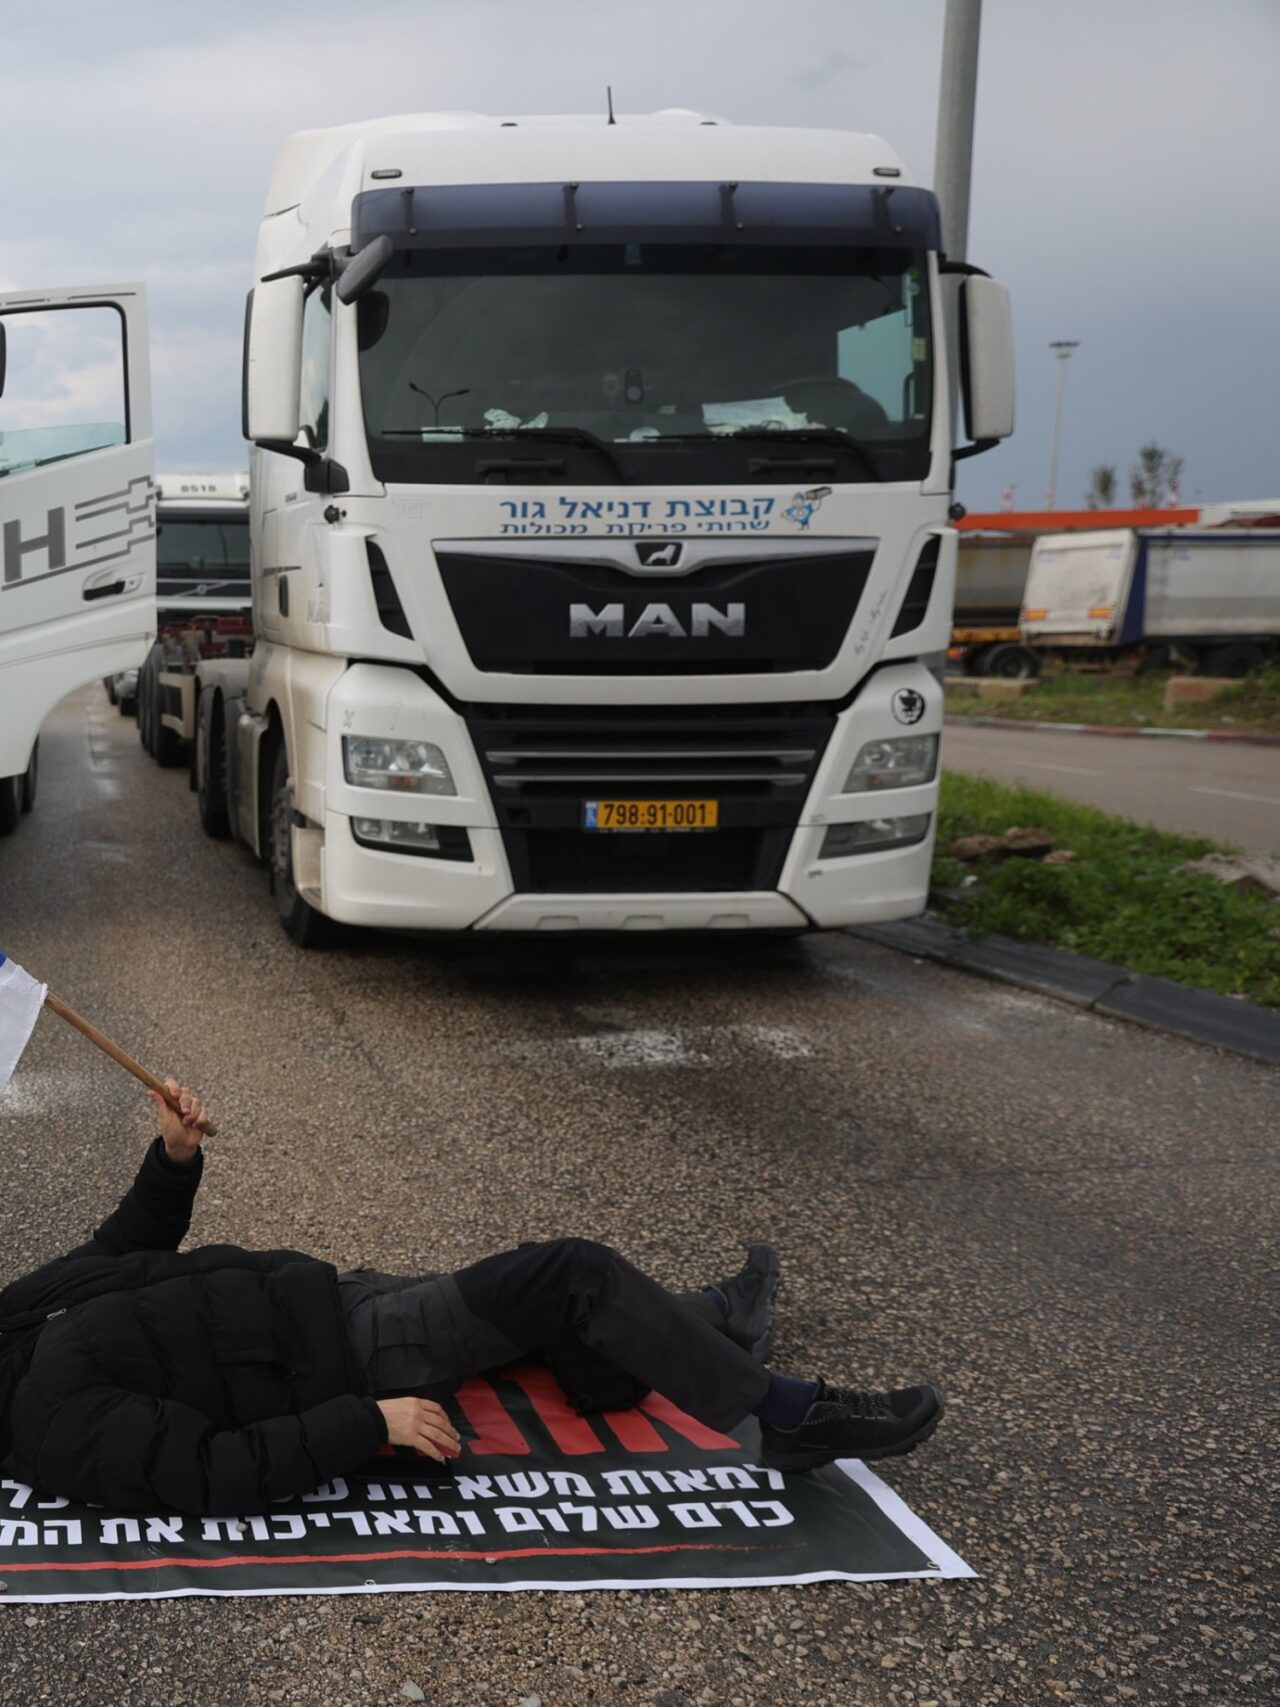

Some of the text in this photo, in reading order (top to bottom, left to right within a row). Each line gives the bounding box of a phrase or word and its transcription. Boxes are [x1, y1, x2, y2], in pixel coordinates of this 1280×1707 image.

[499, 497, 776, 521] קבוצת דניאל גור
[499, 520, 770, 536] שרותי פריקת מכולות
[569, 603, 746, 638] MAN
[600, 1463, 786, 1498] למאות
[200, 1508, 488, 1543] ומאריכות
[494, 1501, 661, 1534] שלום
[666, 1500, 796, 1529] כרם
[98, 1516, 186, 1546] את
